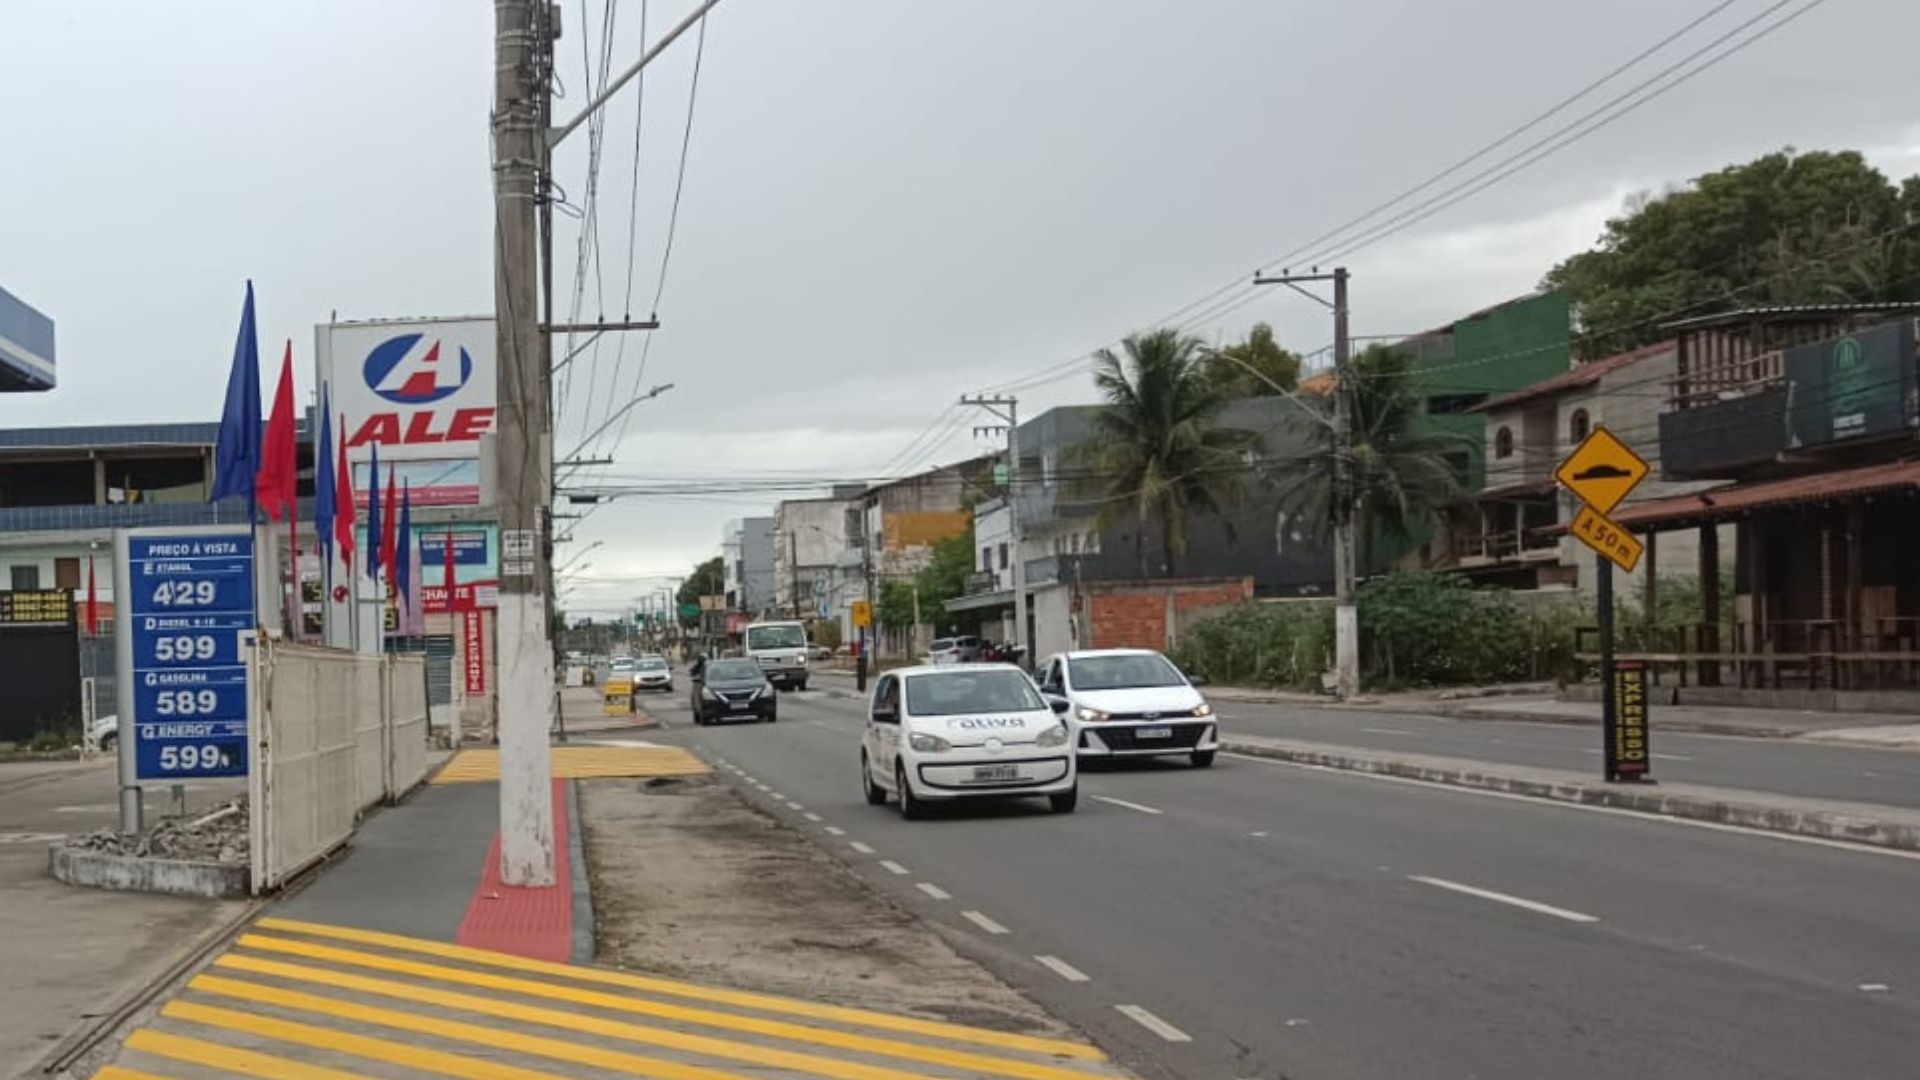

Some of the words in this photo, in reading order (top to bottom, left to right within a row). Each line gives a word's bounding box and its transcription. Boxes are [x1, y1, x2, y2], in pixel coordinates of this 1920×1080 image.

[346, 407, 496, 447] ALE
[149, 543, 190, 556] PREÇO
[203, 543, 238, 554] VISTA
[1593, 524, 1619, 549] 50
[1616, 544, 1631, 560] m
[143, 560, 155, 575] E
[145, 617, 156, 630] D
[1623, 671, 1643, 760] EXPRESSO
[158, 724, 215, 738] ENERGY
